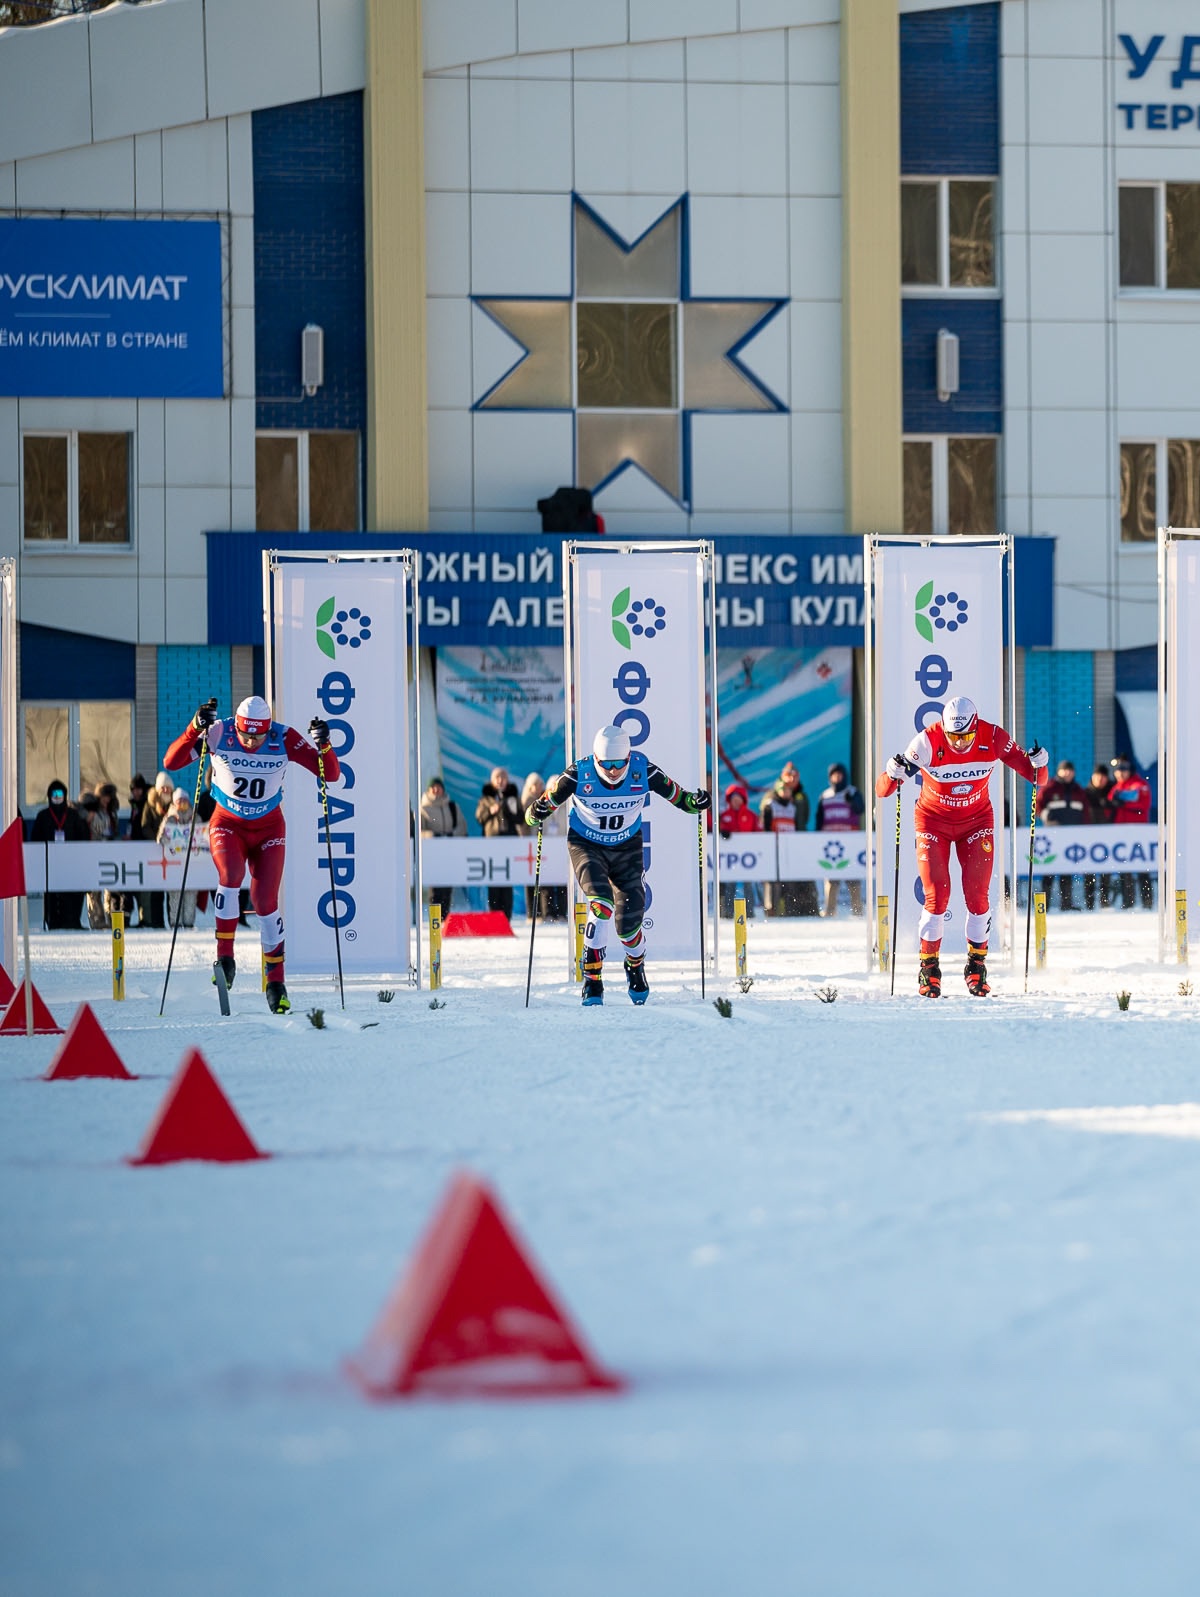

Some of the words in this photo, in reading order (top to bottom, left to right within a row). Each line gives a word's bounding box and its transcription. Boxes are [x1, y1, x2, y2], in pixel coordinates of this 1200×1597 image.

[29, 331, 101, 348] КЛИМАТ
[107, 332, 117, 348] В
[122, 332, 188, 349] СТРАНЕ
[231, 758, 283, 769] ФОСАГРО
[233, 777, 266, 800] 20
[597, 814, 625, 831] 10
[585, 829, 631, 843] ИЖЕВСК
[1038, 902, 1045, 914] 3
[432, 918, 441, 929] 5
[737, 914, 745, 926] 4
[113, 928, 122, 940] 6
